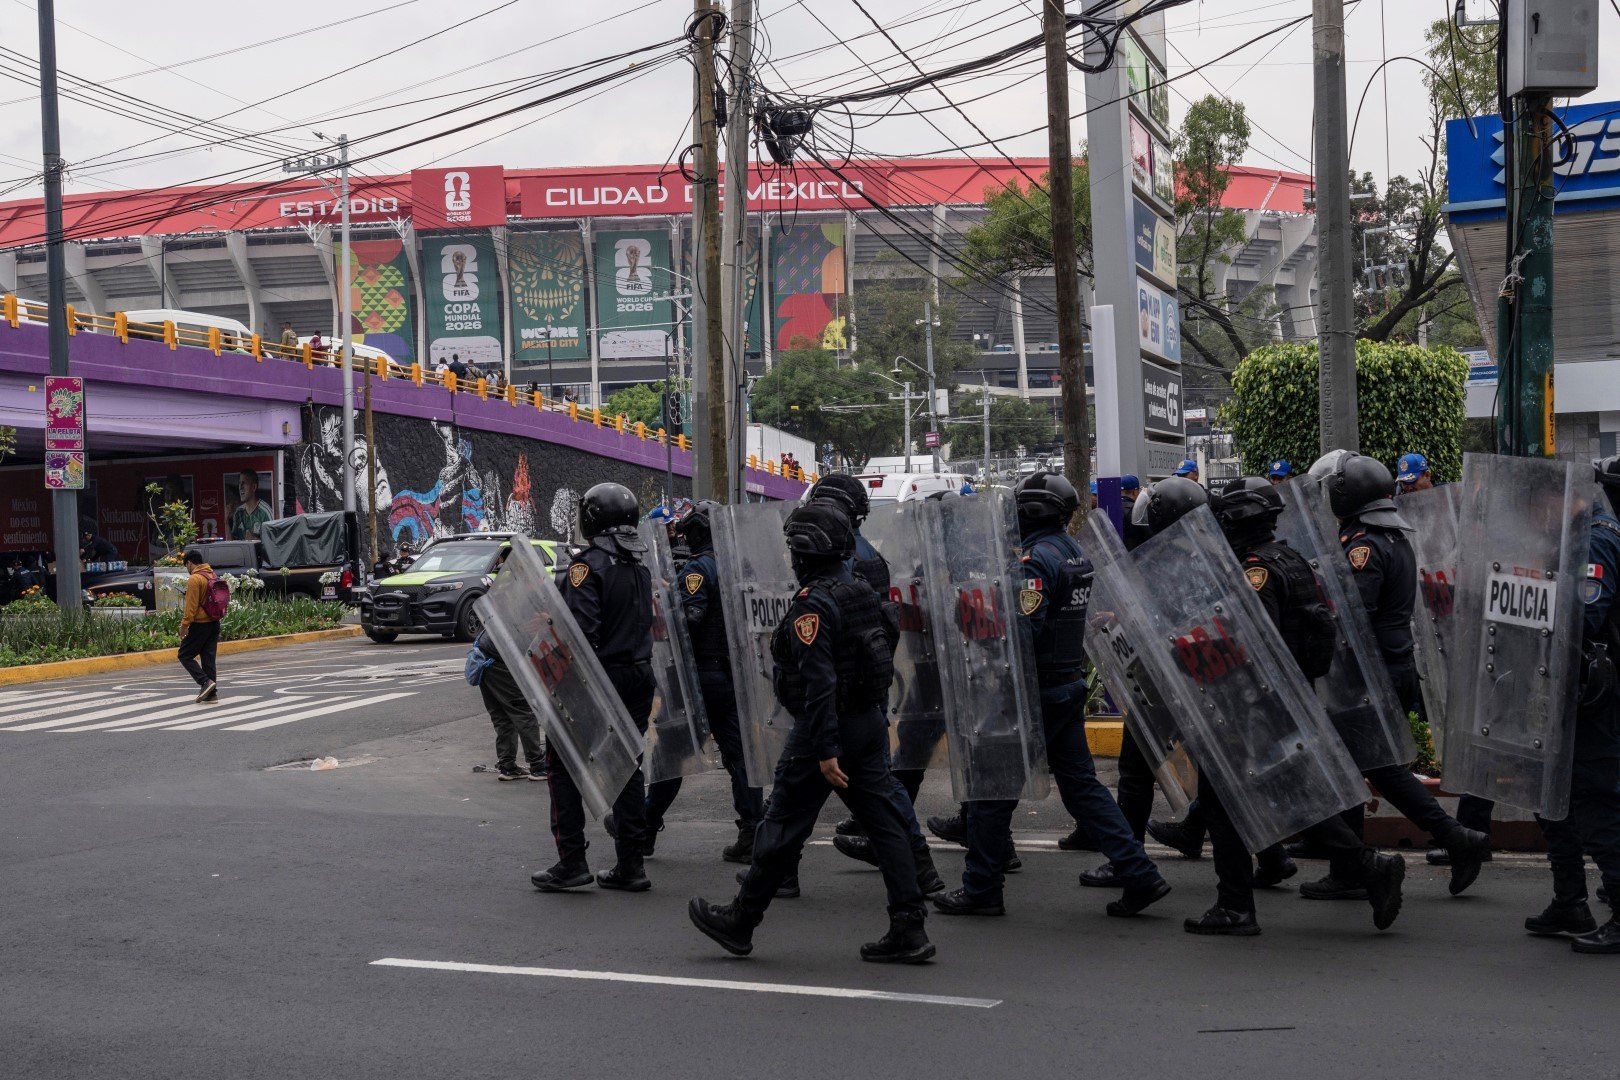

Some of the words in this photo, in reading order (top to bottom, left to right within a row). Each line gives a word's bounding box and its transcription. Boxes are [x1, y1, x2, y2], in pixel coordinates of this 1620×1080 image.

[545, 185, 669, 206] CIUDAD
[746, 178, 864, 201] MÉXICO
[280, 197, 398, 217] ESTADIO
[626, 283, 643, 291] FIFA
[453, 289, 470, 297] FIFA
[444, 303, 481, 314] COPA
[617, 303, 653, 312] 2026
[444, 314, 481, 322] MUNDIAL
[445, 321, 482, 331] 2026
[559, 338, 579, 348] CITY
[1488, 579, 1549, 622] POLICIA
